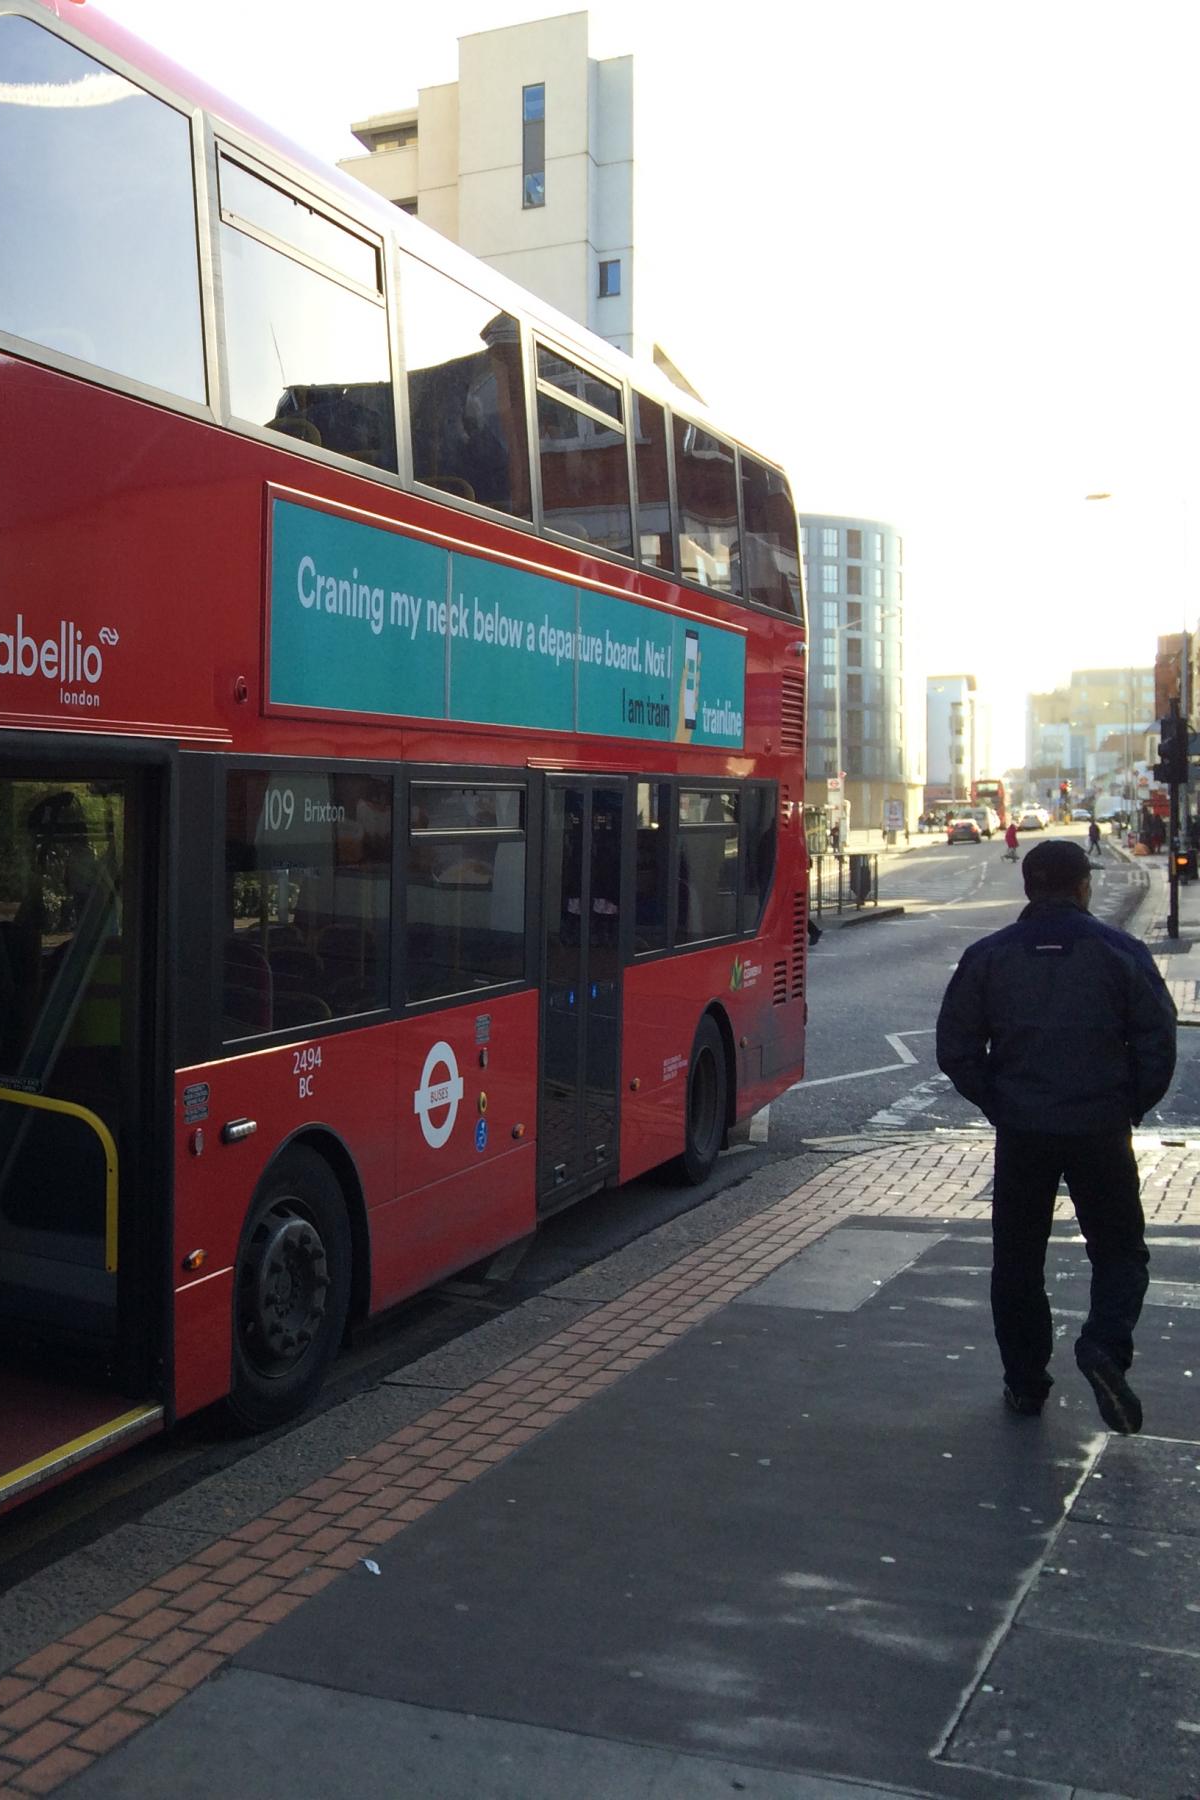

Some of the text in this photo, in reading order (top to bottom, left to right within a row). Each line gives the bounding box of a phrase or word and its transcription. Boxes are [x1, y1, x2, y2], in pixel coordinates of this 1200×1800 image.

[297, 555, 384, 635] Craning
[390, 591, 422, 640] my
[427, 593, 469, 639] neck
[474, 597, 523, 649] below
[526, 622, 535, 652] a
[539, 613, 602, 667] departure
[605, 629, 642, 673] board.
[644, 640, 666, 678] Not
[60, 687, 100, 707] london
[628, 699, 645, 725] am
[647, 694, 670, 728] train
[702, 698, 742, 736] trainline
[264, 788, 345, 831] 109 Brixton
[293, 1046, 322, 1074] 2494
[299, 1074, 314, 1098] BC
[430, 1086, 449, 1105] BUSES
